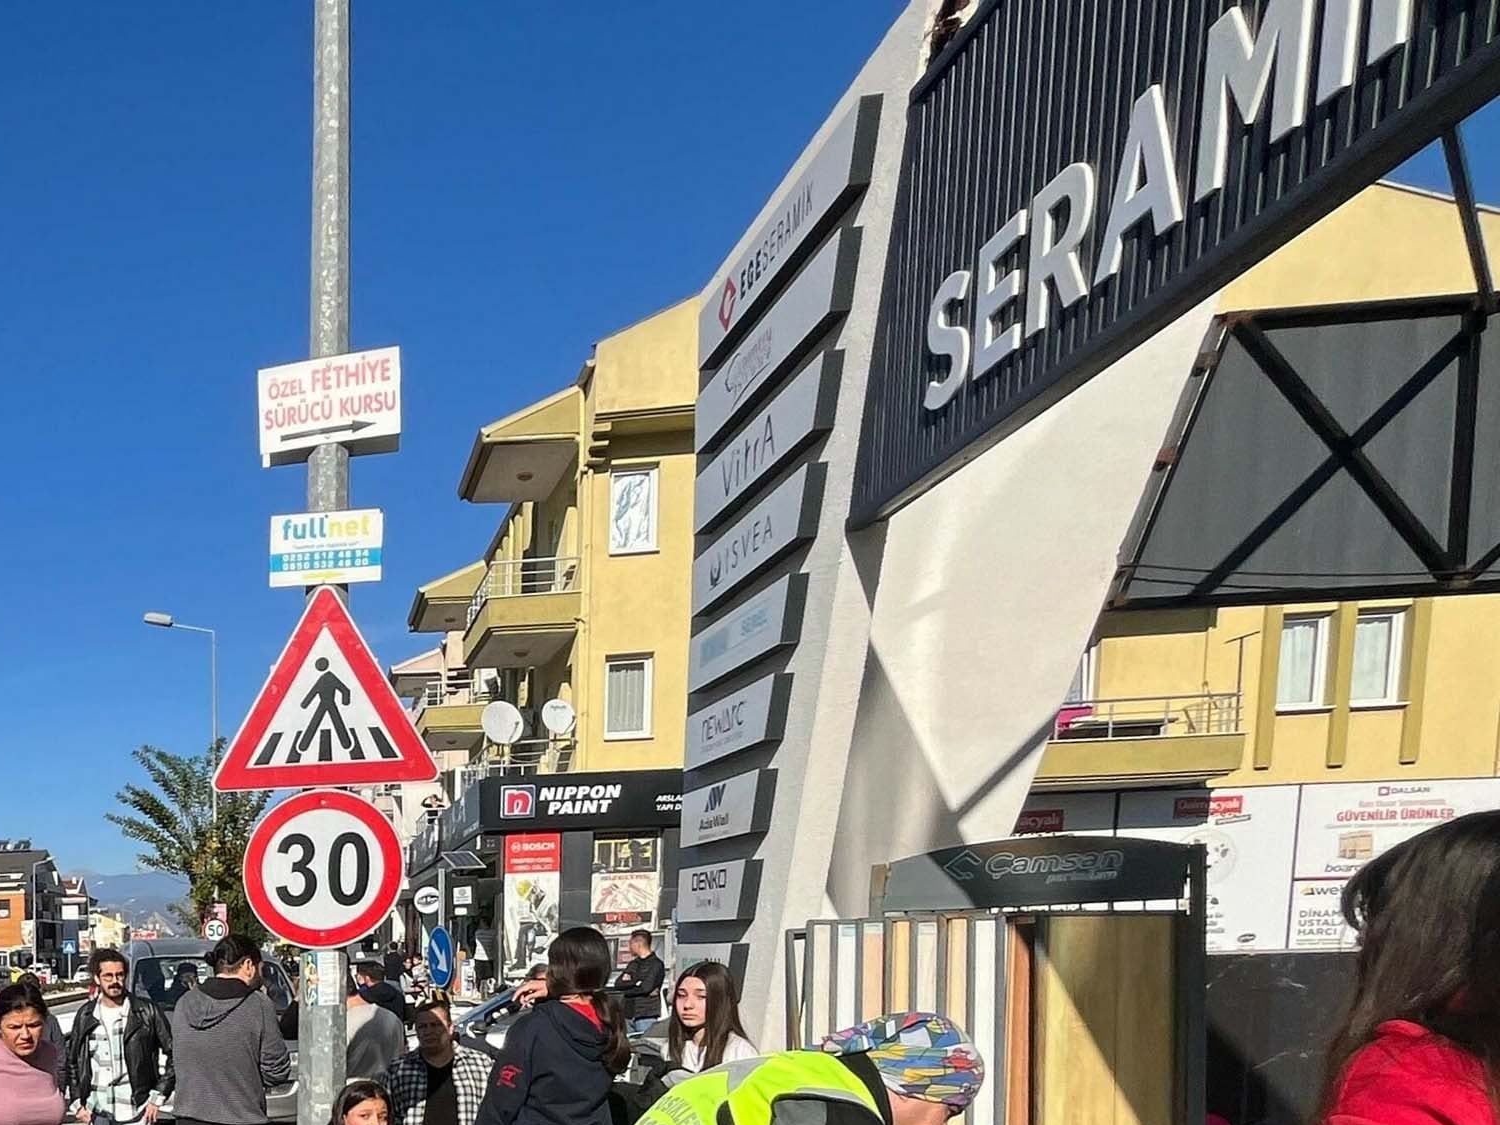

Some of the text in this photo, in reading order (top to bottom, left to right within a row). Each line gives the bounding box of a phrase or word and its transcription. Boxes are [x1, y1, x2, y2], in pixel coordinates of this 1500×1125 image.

[268, 354, 391, 400] ÖZEL FETHİYE
[264, 389, 396, 430] SÜRÜCÜ KURSU
[722, 414, 775, 497] VitrA
[539, 783, 622, 802] NIPPON
[547, 799, 613, 815] PAINT
[1336, 806, 1455, 823] GÜVENİLİR ÜRÜNLER
[275, 831, 370, 908] 30
[985, 850, 1124, 880] Çamsan
[1299, 908, 1342, 918] DİNAM
[208, 924, 224, 937] 50
[1297, 927, 1337, 937] HARCI
